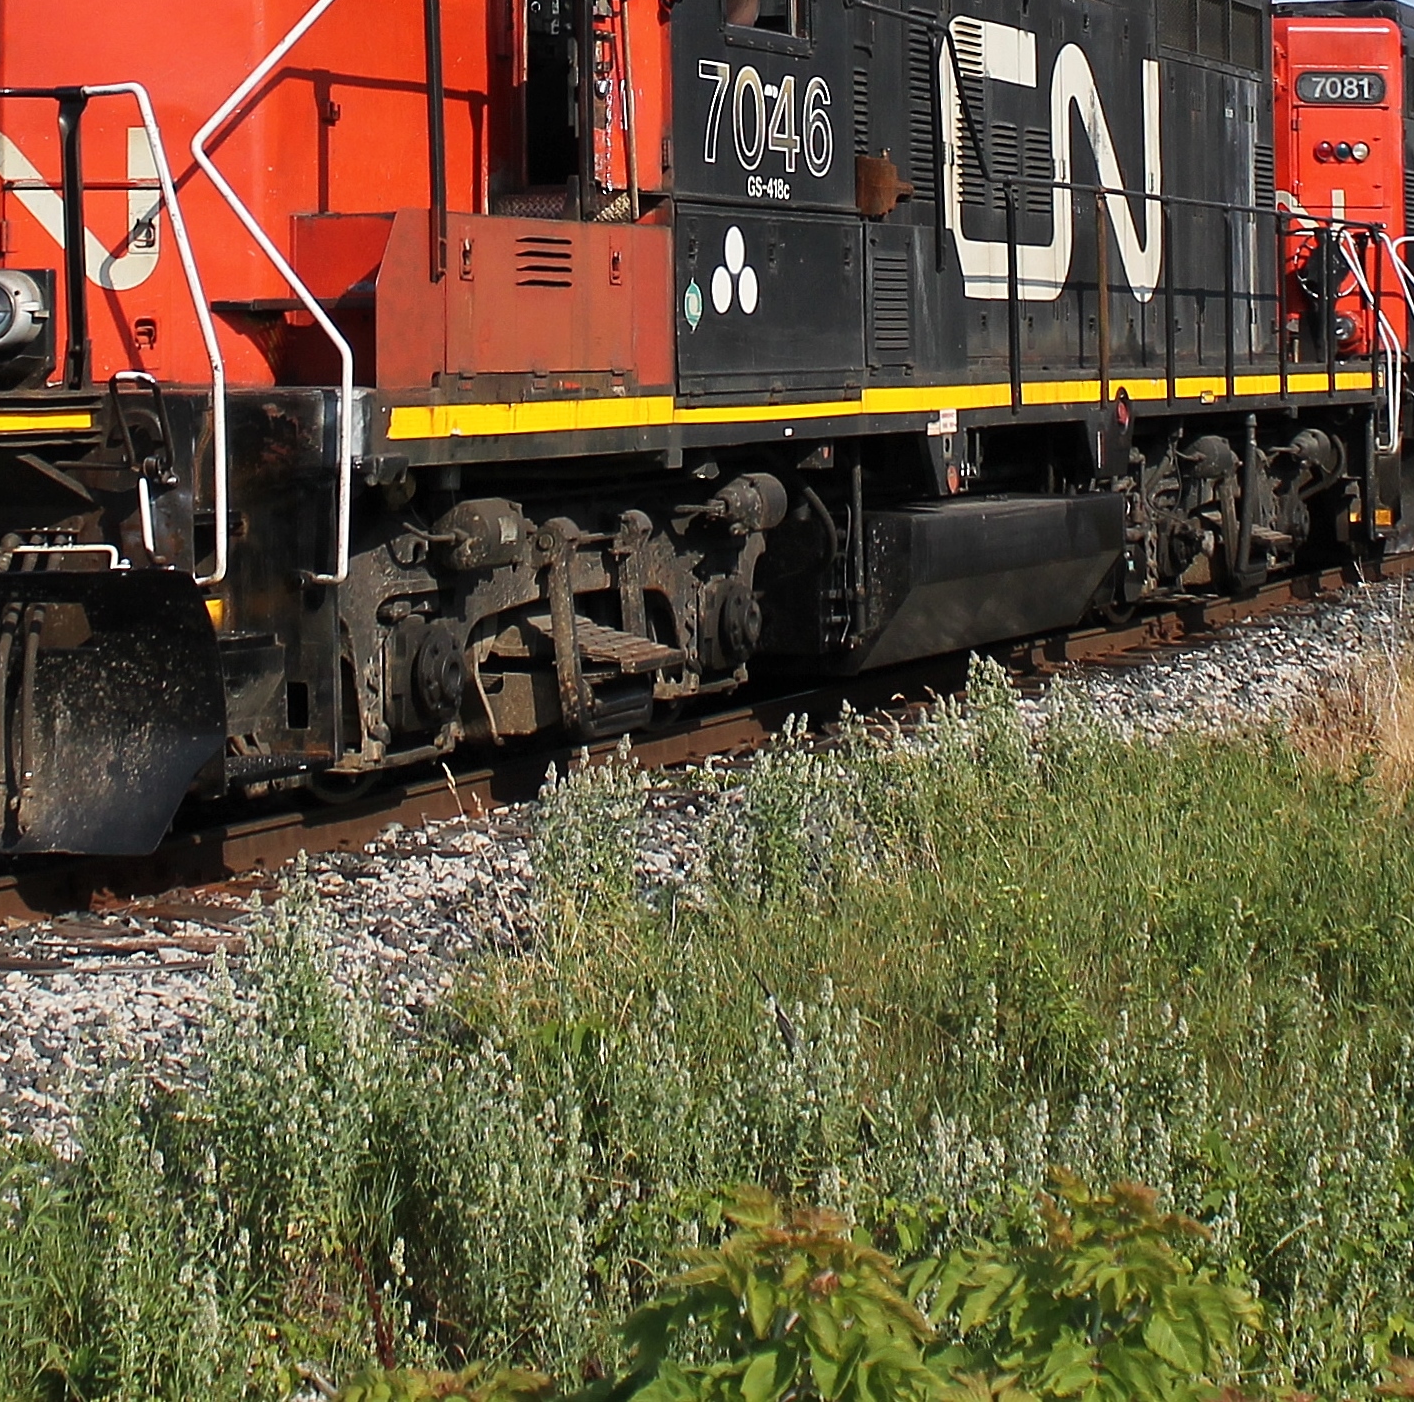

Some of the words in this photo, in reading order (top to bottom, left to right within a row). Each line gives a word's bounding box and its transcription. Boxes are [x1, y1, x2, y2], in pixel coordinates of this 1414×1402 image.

[698, 59, 833, 178] 7046
[1311, 77, 1369, 98] 7081
[747, 175, 791, 200] GS-418c
[939, 15, 1162, 303] CN
